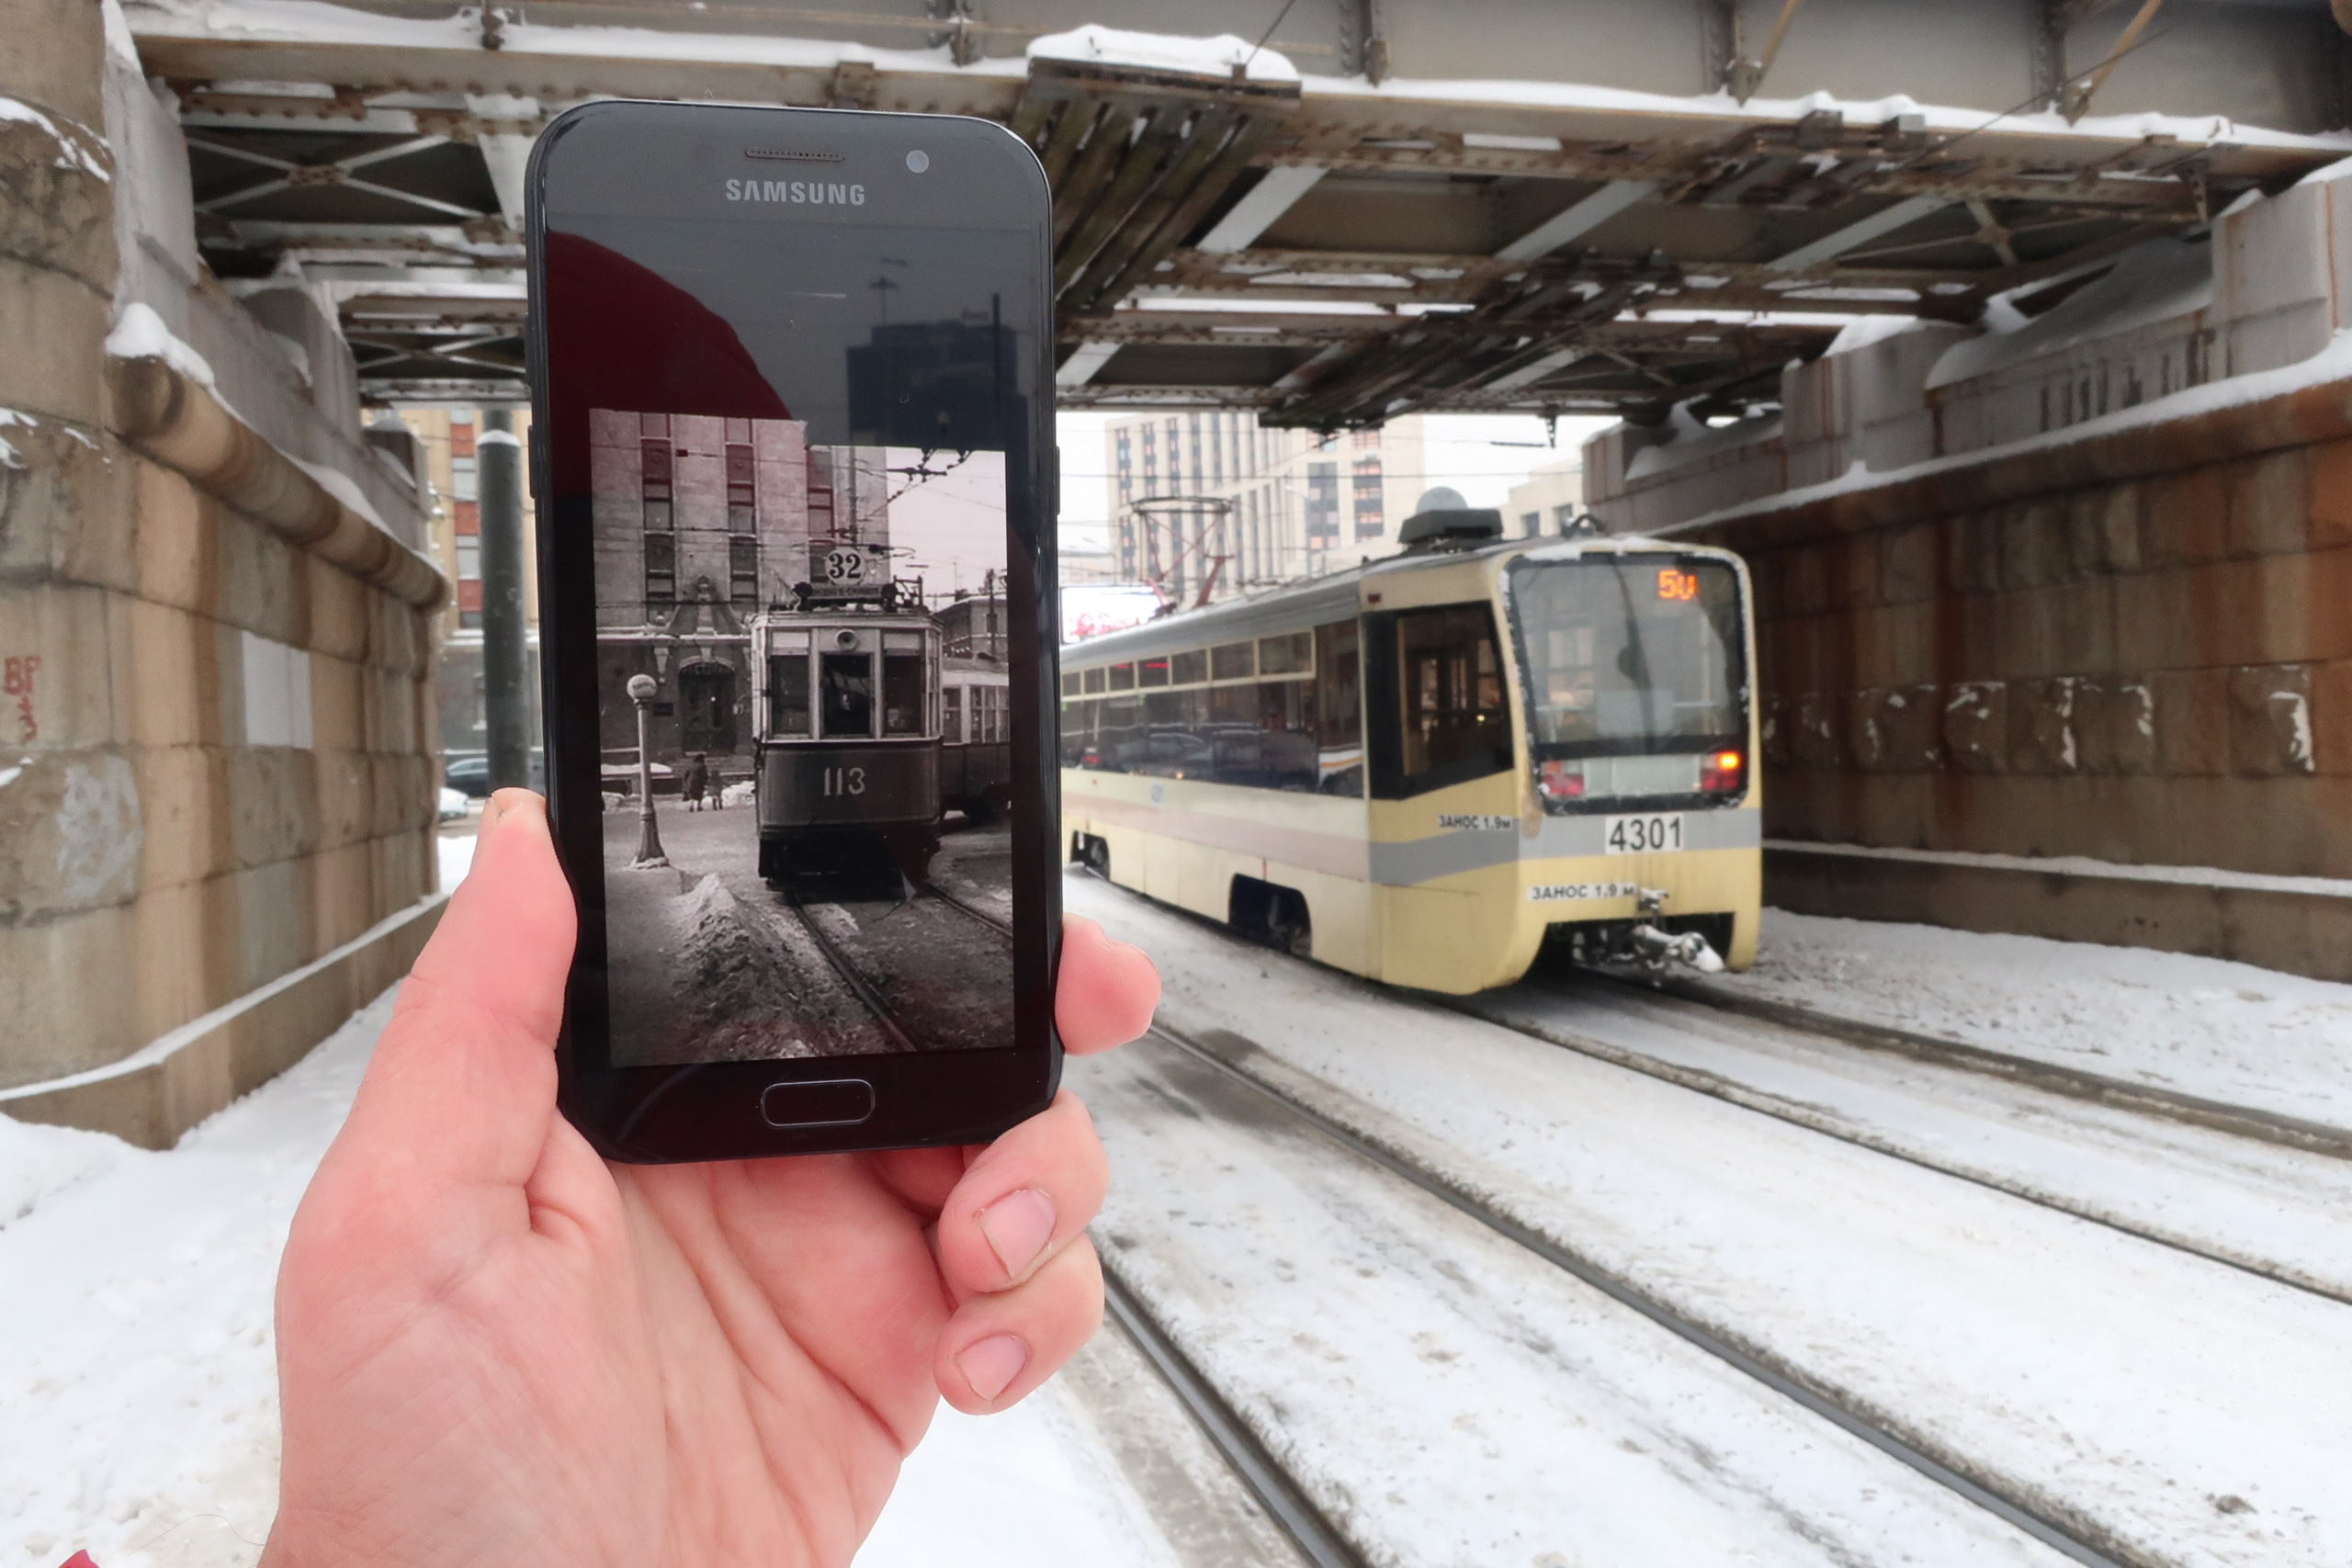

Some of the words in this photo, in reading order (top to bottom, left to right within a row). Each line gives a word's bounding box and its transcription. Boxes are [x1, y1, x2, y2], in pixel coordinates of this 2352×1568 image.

[726, 179, 865, 206] SAMSUNG
[828, 553, 862, 579] 32
[824, 767, 865, 796] 113
[1610, 817, 1681, 851] 4301
[1532, 885, 1589, 900] ЗАНОС
